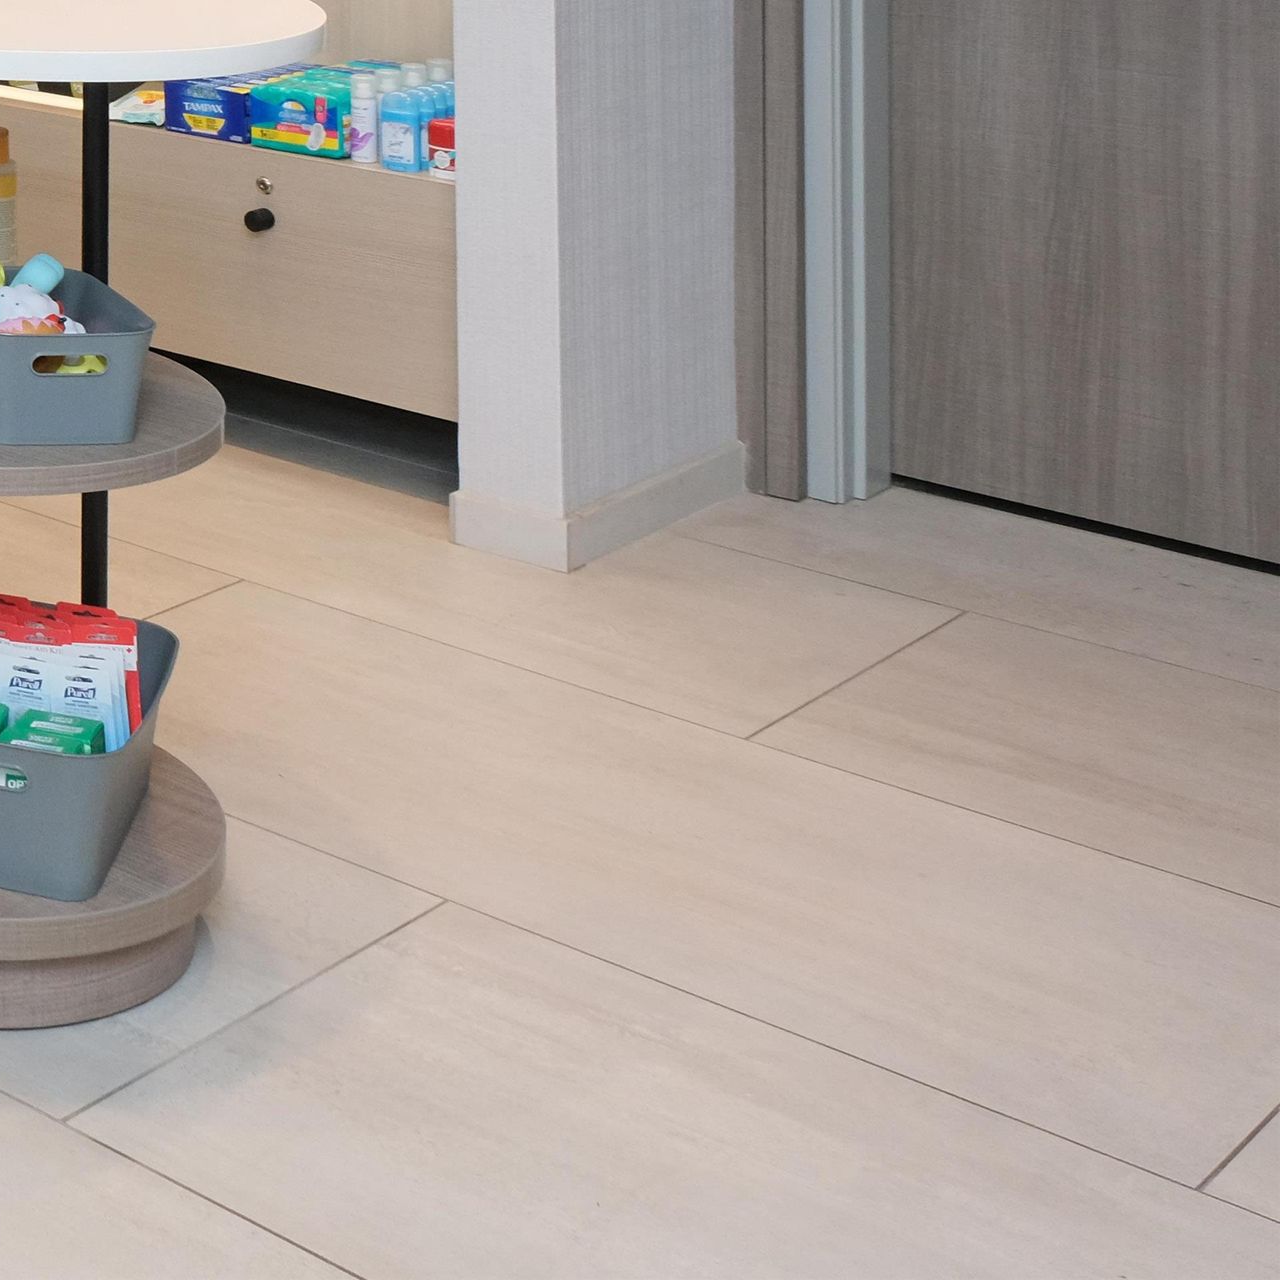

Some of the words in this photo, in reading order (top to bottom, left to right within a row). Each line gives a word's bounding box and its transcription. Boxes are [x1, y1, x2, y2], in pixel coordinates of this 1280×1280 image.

[183, 101, 223, 114] TAMPAX
[13, 677, 41, 690] Purell
[67, 687, 95, 699] Purell
